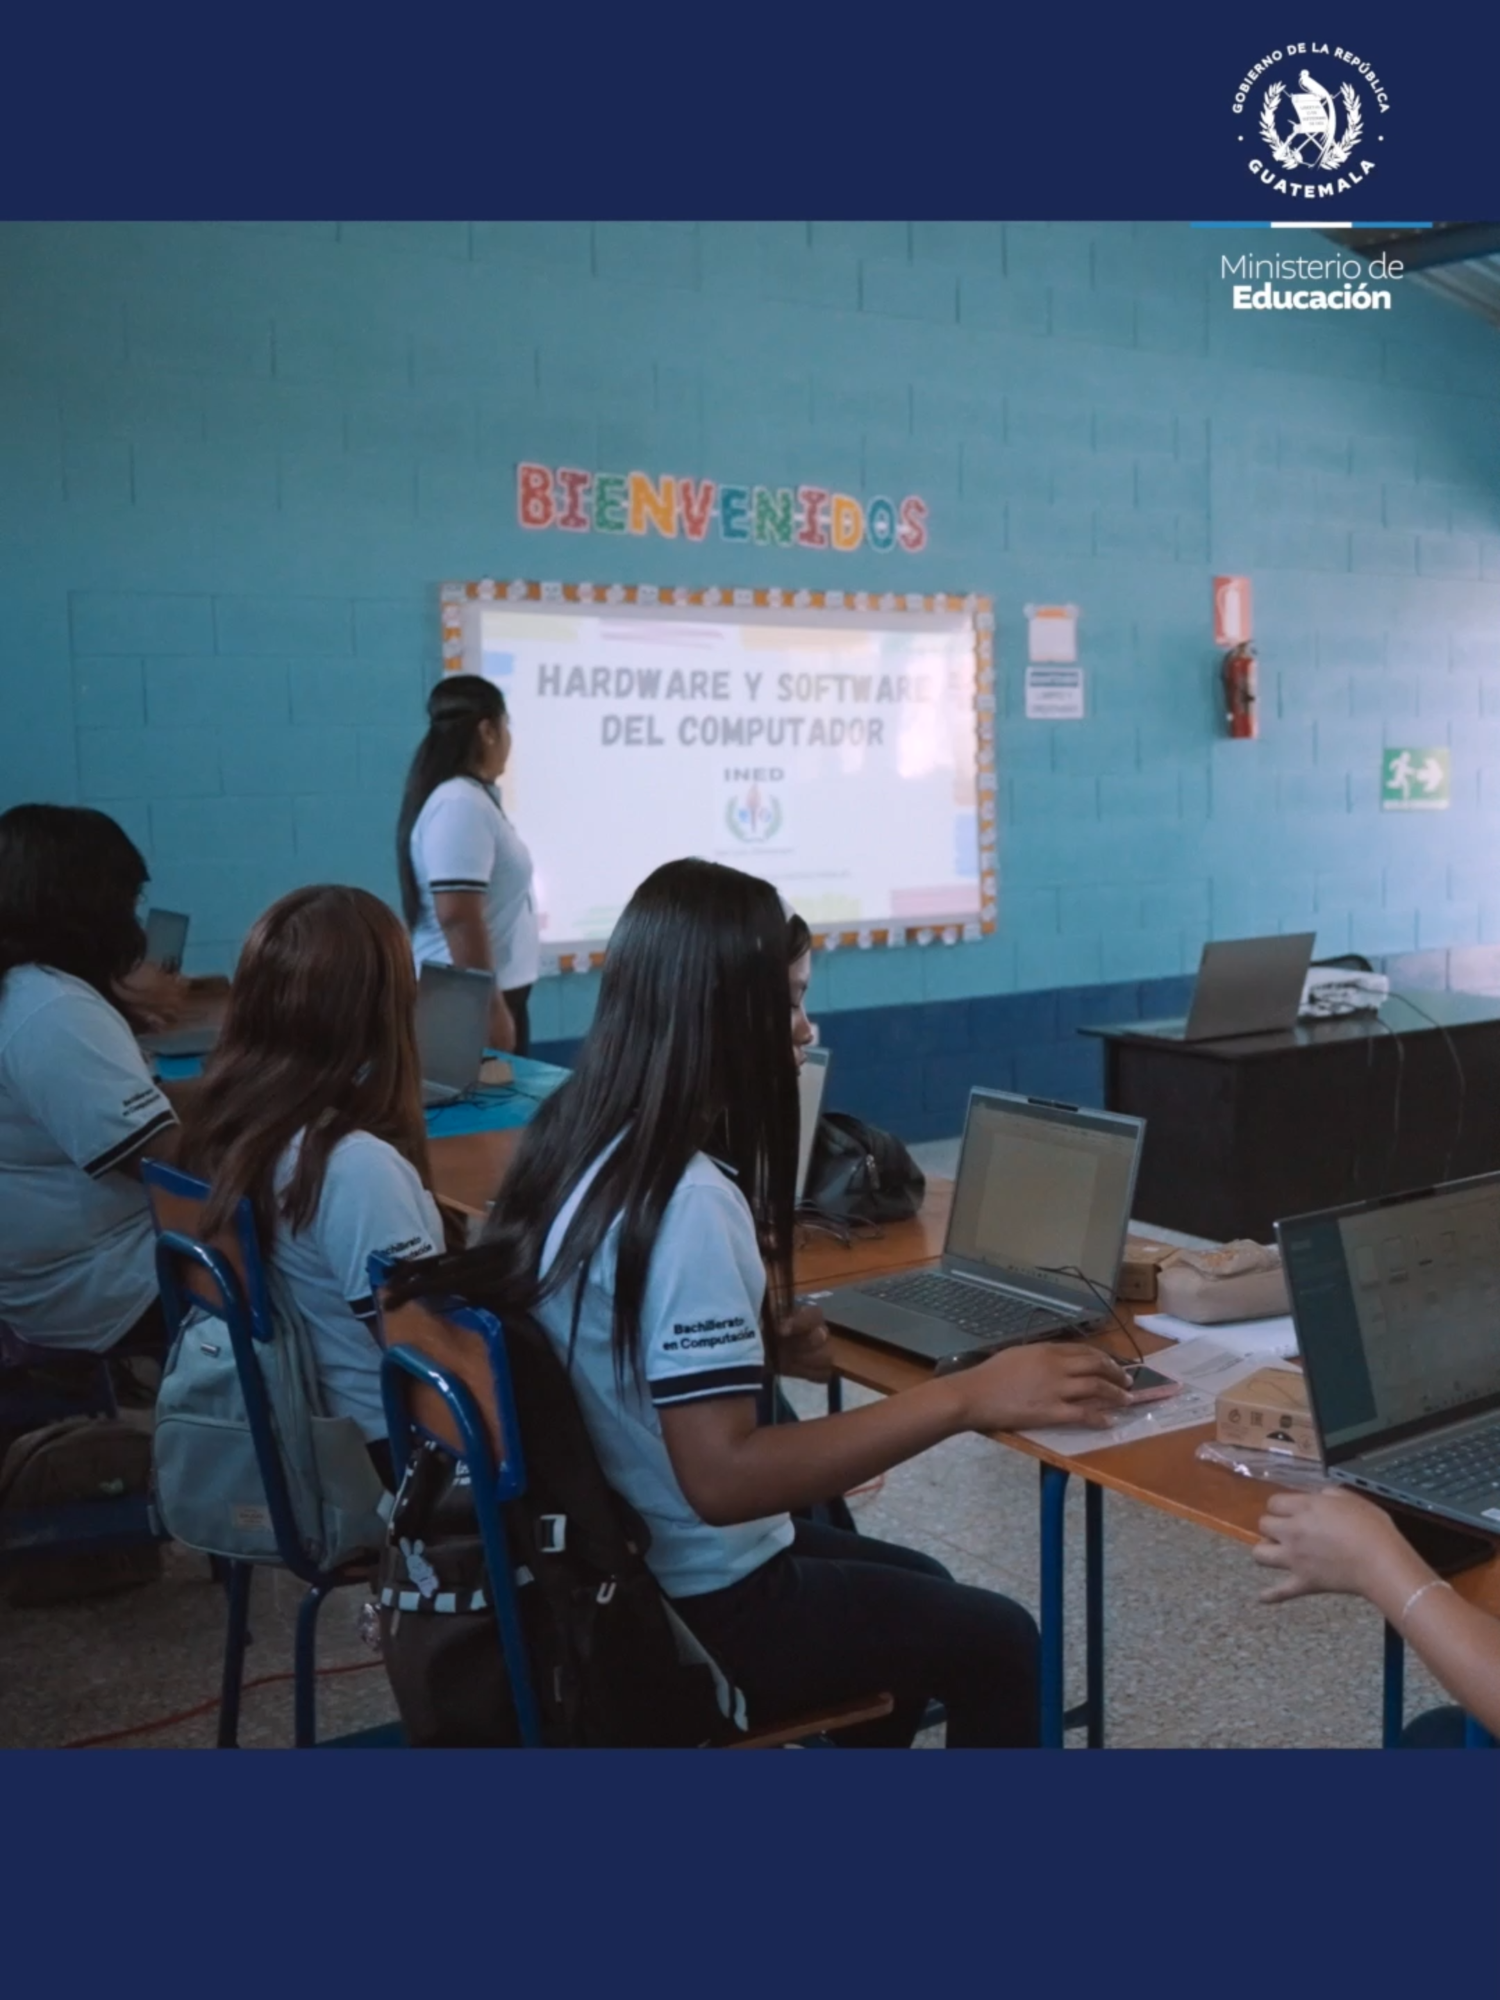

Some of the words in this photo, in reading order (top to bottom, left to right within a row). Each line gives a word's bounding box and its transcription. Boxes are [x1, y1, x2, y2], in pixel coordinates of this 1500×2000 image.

[516, 462, 928, 553] BIENVENIDOS
[537, 664, 730, 701] HARDWARE
[743, 671, 763, 702] Y
[601, 715, 665, 747] DEL
[677, 716, 885, 747] COMPUTADOR
[724, 767, 785, 782] INED
[662, 1341, 678, 1351] en
[680, 1327, 756, 1349] Computación
[673, 1317, 745, 1335] Bachillerato
